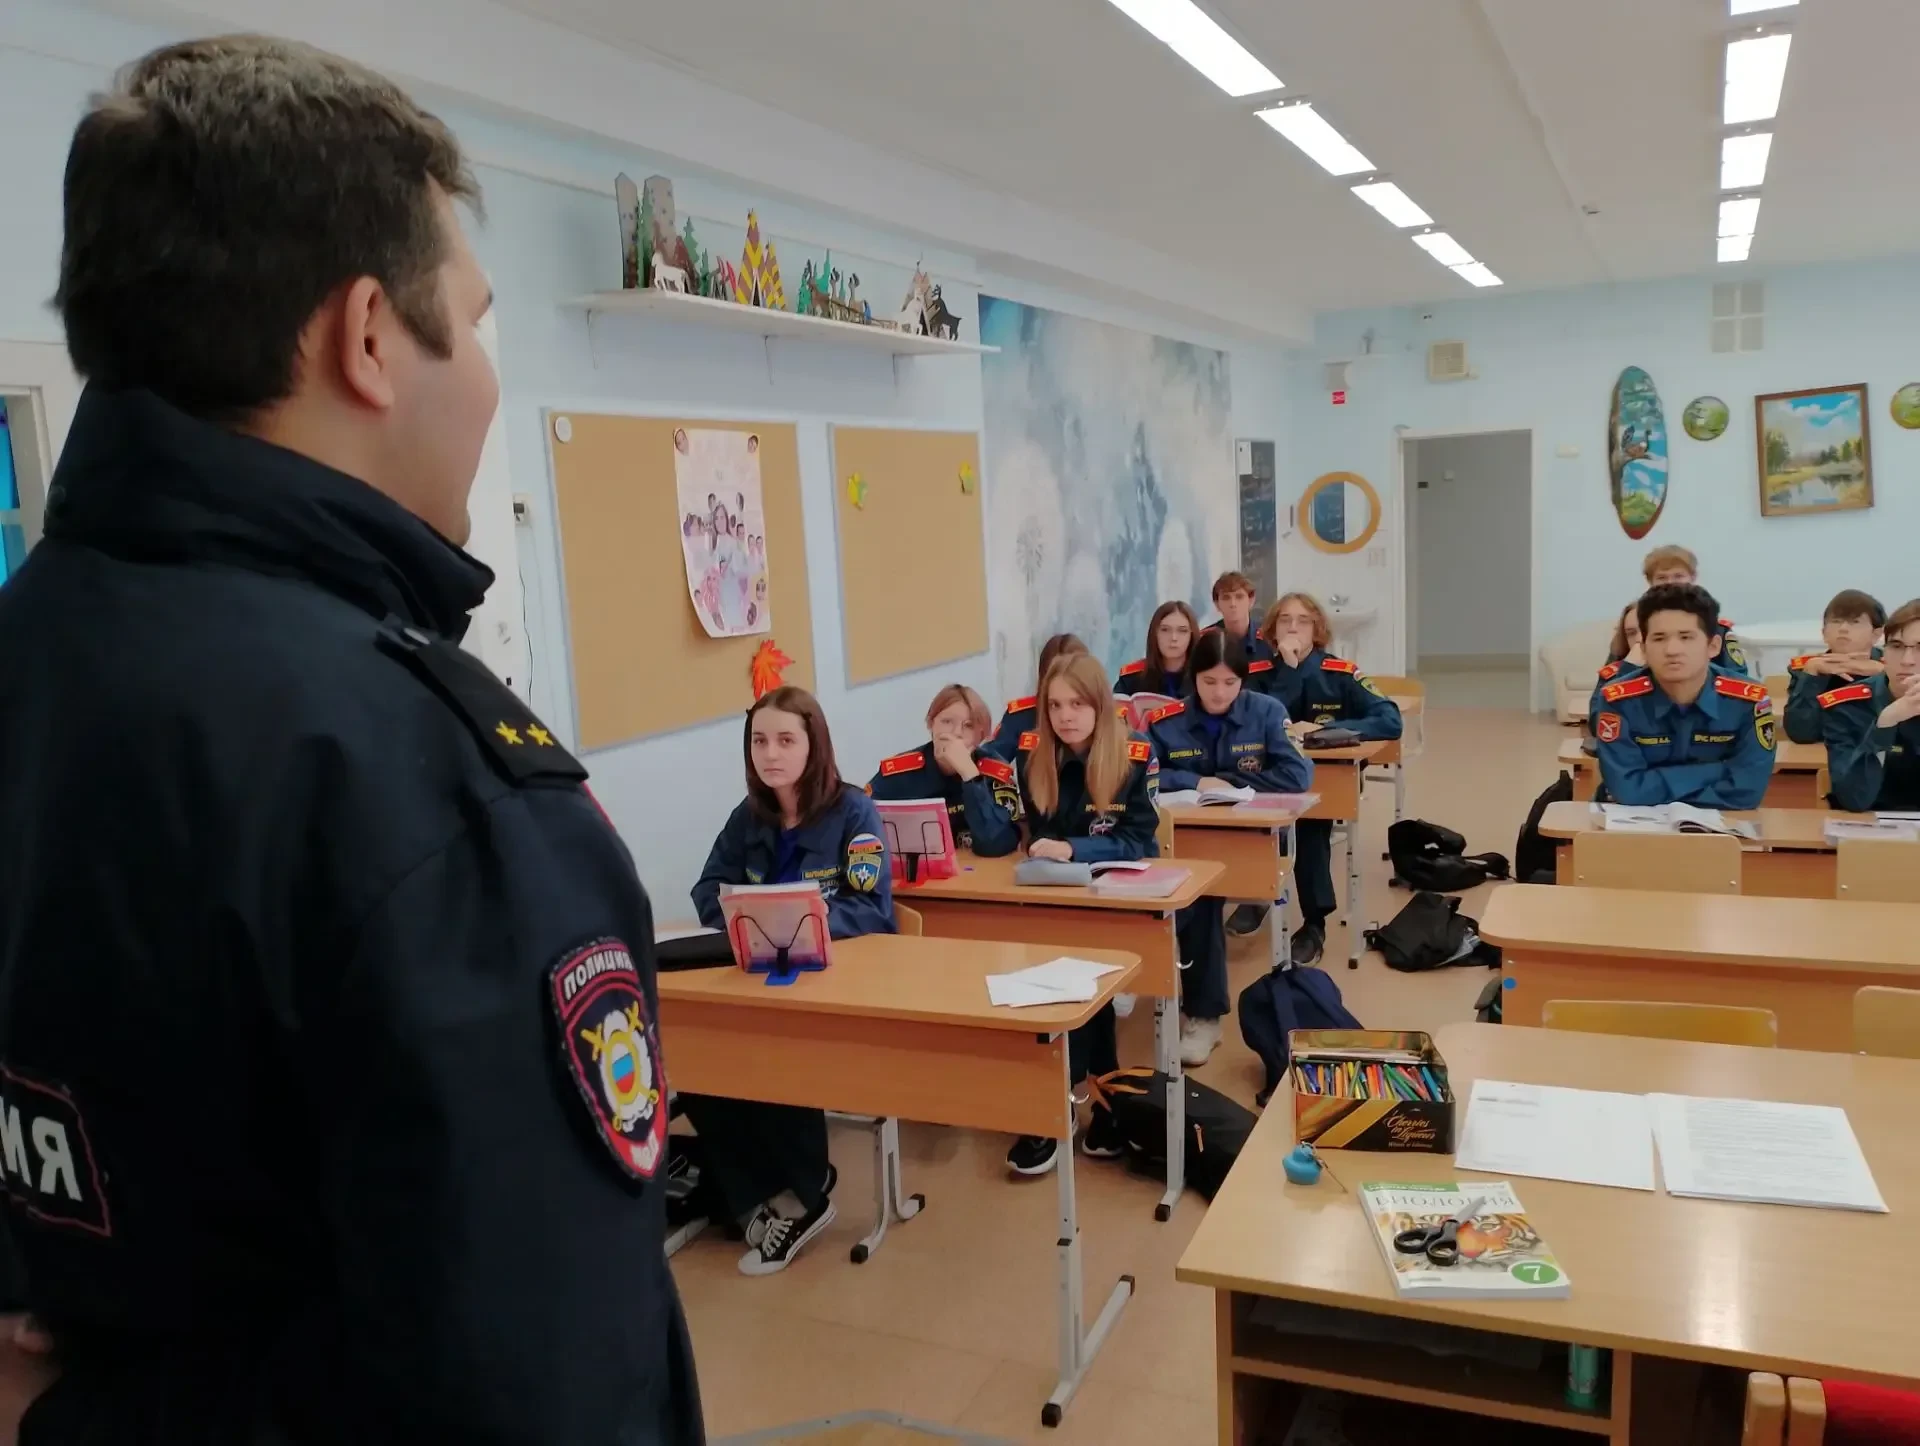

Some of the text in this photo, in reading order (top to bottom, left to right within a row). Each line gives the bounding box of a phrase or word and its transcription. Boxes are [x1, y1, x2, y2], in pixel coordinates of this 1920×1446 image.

[563, 949, 634, 1001] ПОЛИЦИЯ
[0, 1095, 83, 1203] ИЯ
[1522, 1265, 1541, 1281] 7
